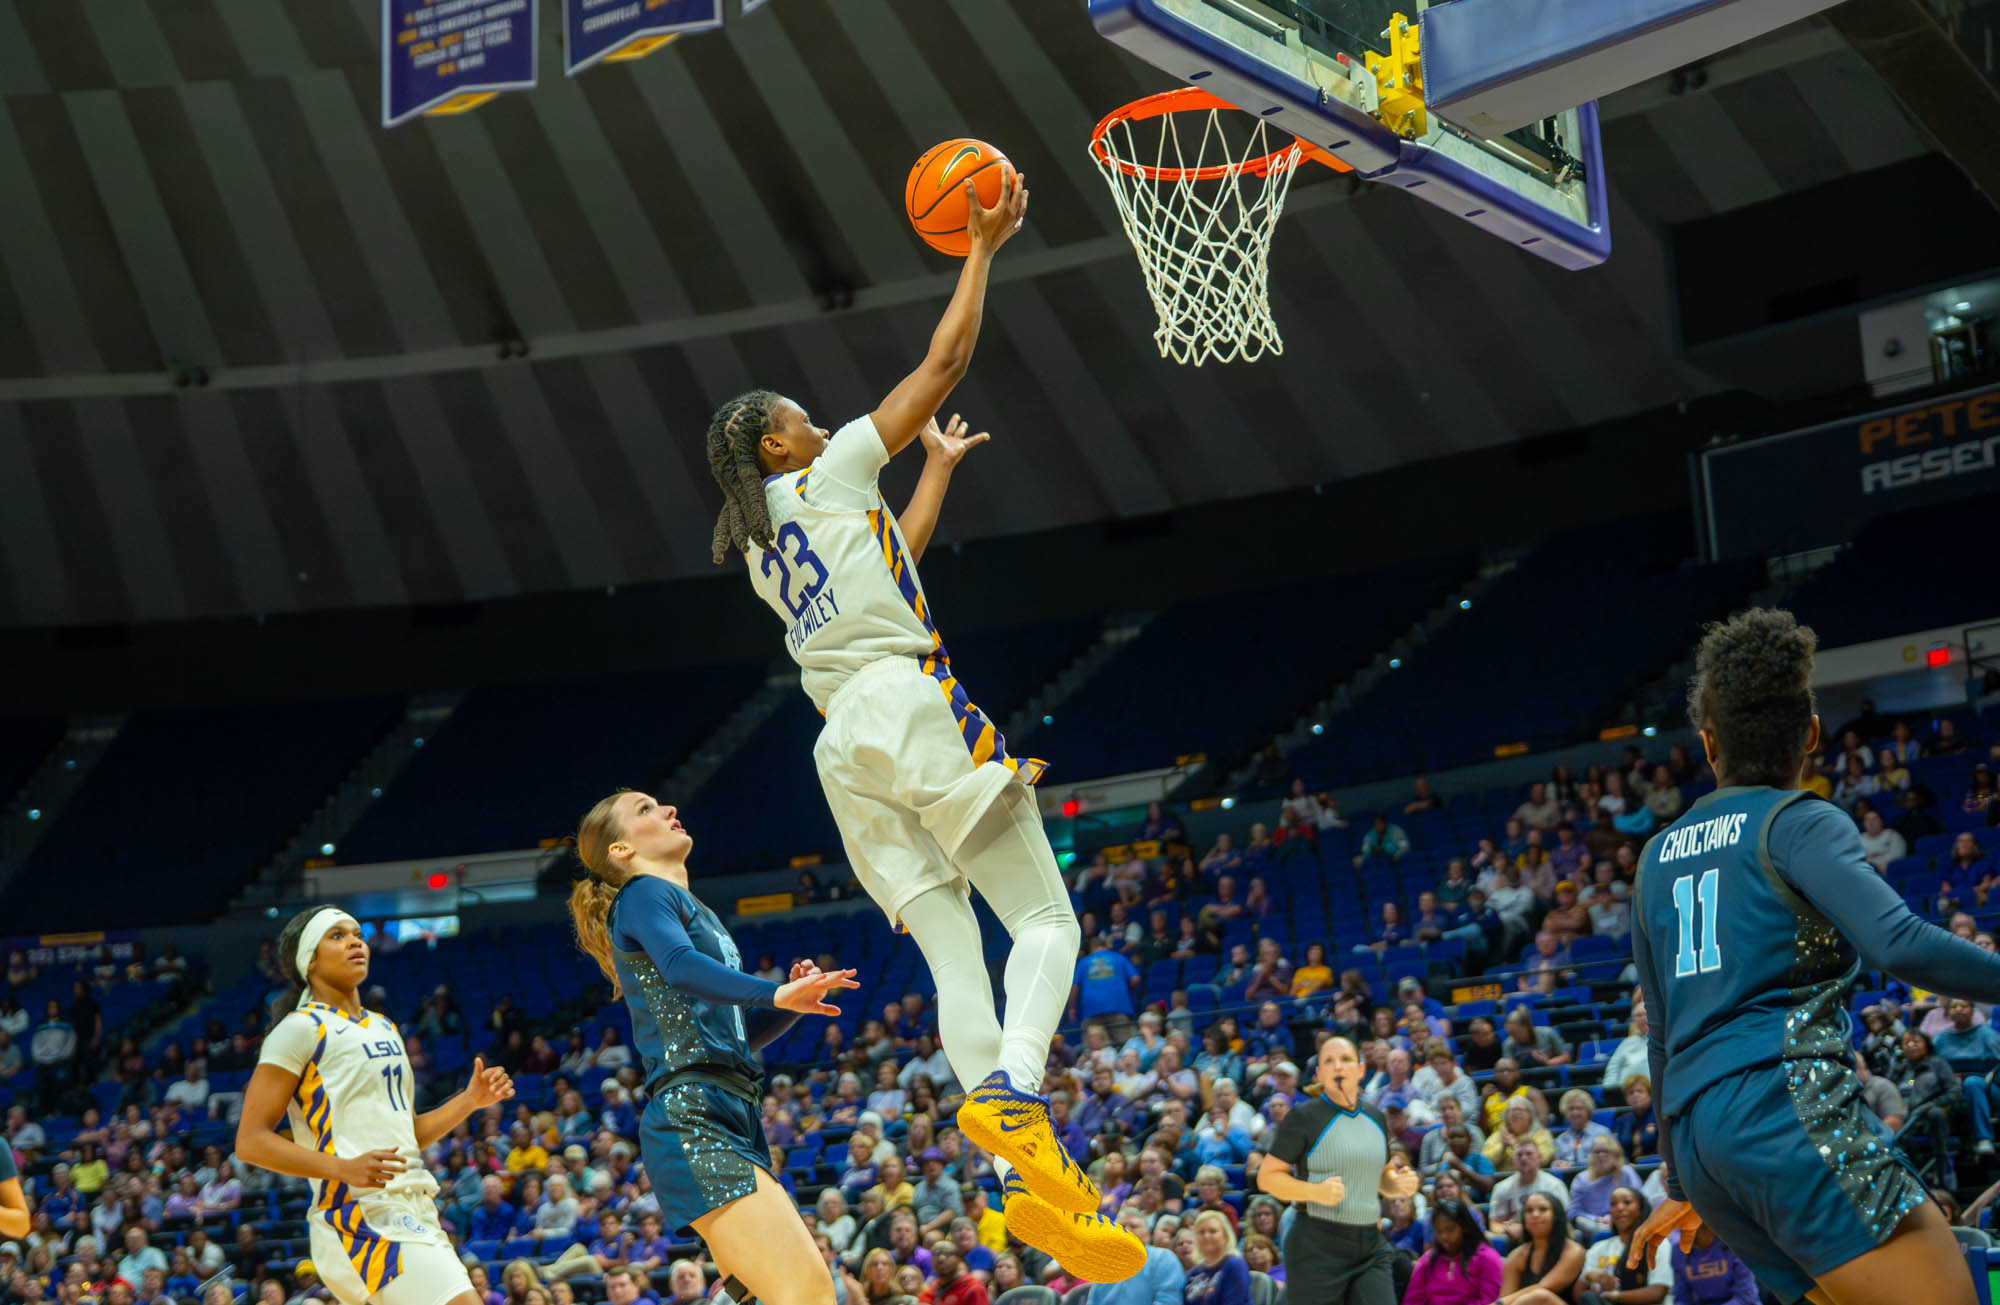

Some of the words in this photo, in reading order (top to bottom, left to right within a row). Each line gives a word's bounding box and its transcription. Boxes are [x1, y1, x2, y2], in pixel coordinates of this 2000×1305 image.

[1858, 391, 2000, 455] PETE
[760, 520, 830, 621] 23
[789, 587, 840, 656] FULWILEY
[1658, 812, 1748, 863] CHOCTAWS
[1672, 867, 1722, 978] 11
[362, 1040, 402, 1059] LSU
[381, 1063, 408, 1112] 11
[1685, 1258, 1729, 1281] LSU
